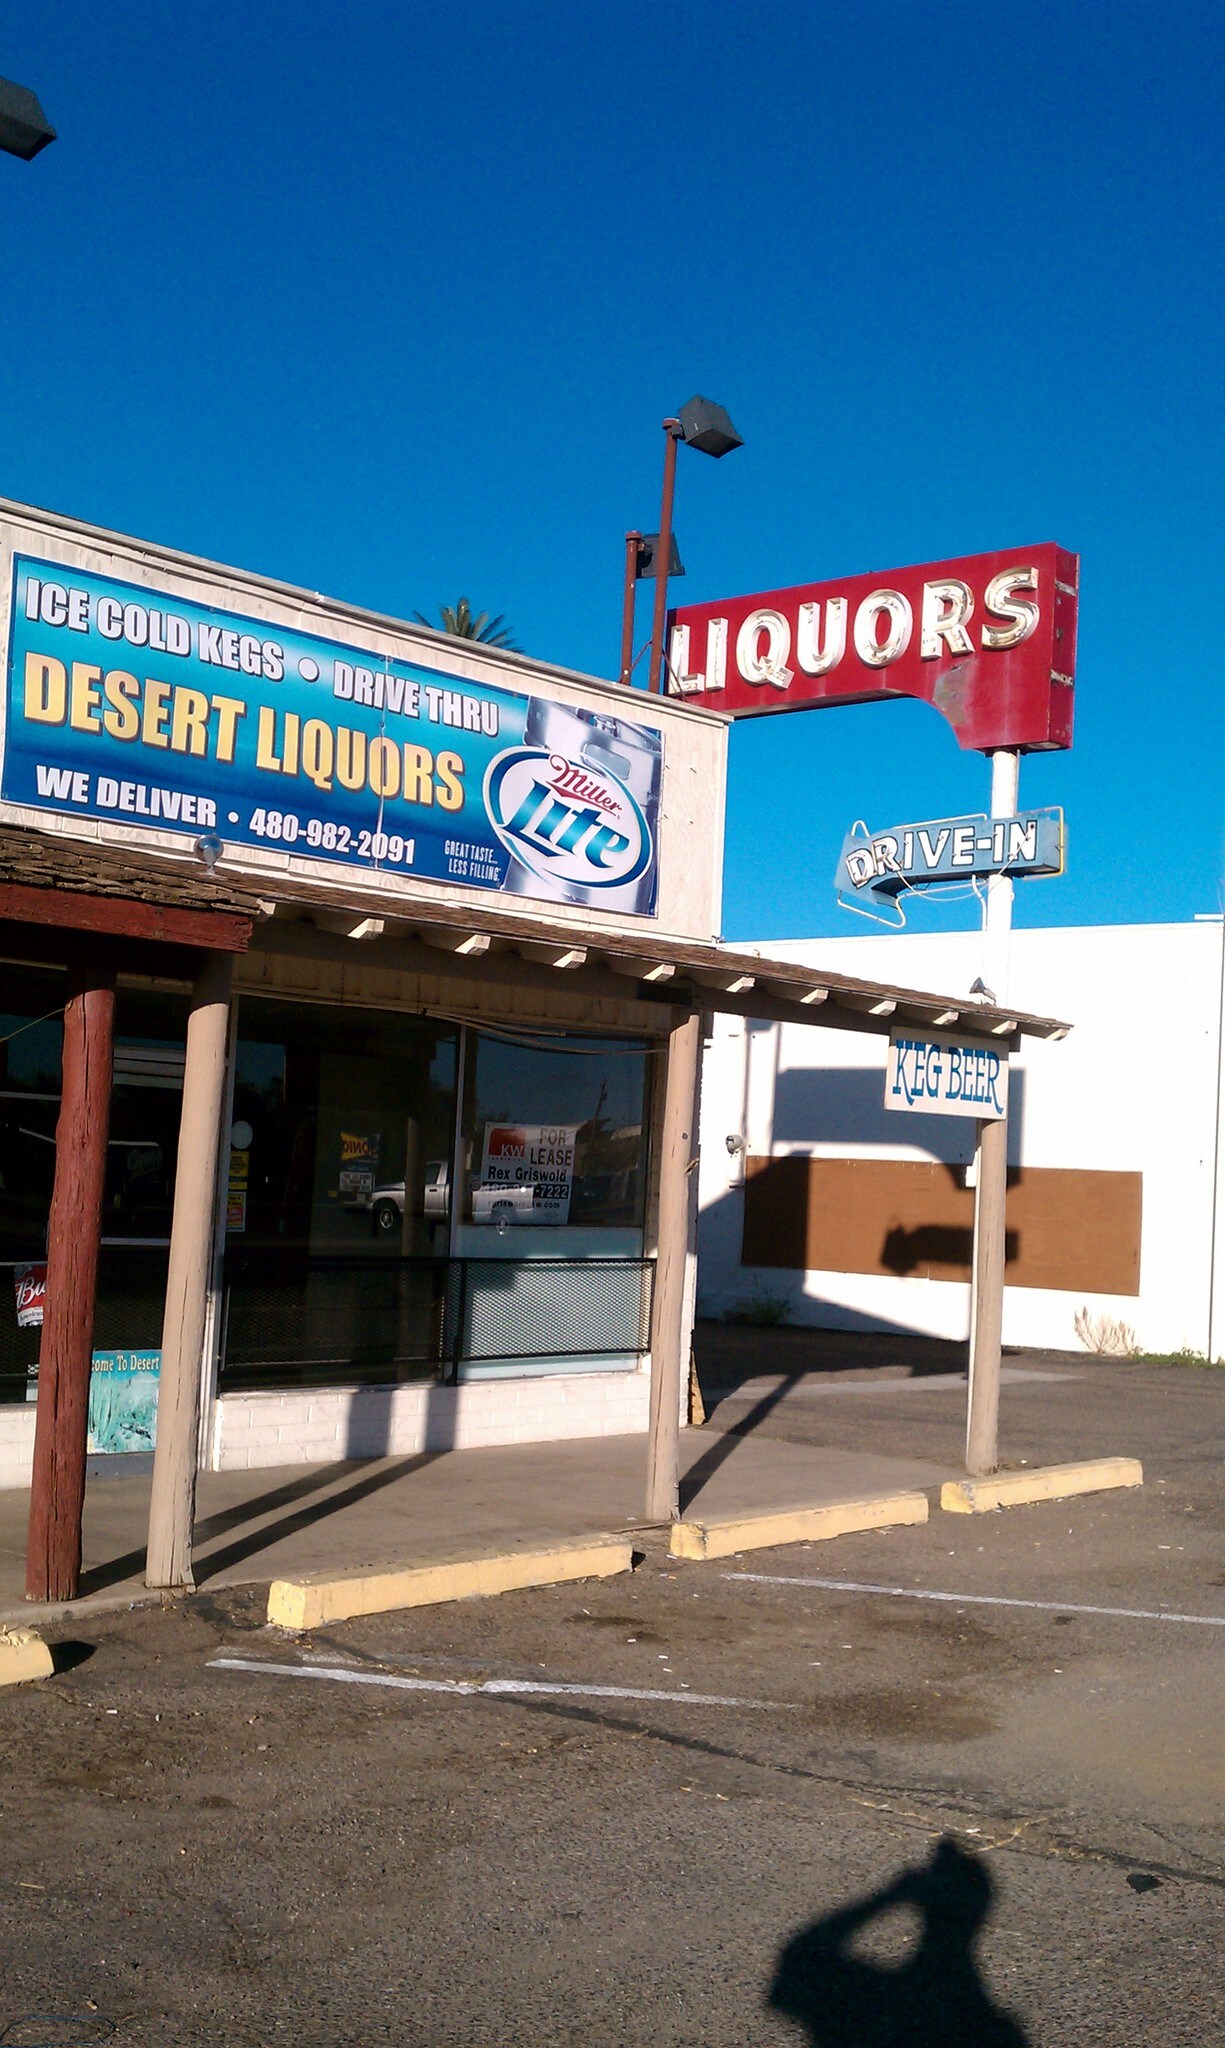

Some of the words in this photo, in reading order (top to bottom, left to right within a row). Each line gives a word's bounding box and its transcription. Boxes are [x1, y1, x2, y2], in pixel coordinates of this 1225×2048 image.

[25, 576, 90, 634] ICE
[97, 596, 191, 657] COLD
[198, 621, 285, 683] KEGS
[333, 659, 421, 720] DRIVE
[424, 685, 499, 738] THRU
[667, 566, 1041, 695] LIQUORS
[24, 650, 248, 763] DESERT
[255, 704, 466, 814] LIQUORS
[549, 754, 622, 812] Miller
[35, 764, 90, 804] WE
[95, 776, 218, 828] DELIVER
[248, 807, 416, 866] 480-982-2091
[501, 777, 631, 869] Lite
[444, 840, 471, 859] GREAT
[448, 857, 468, 876] LESS
[845, 819, 1038, 890] DRIVE-IN
[892, 1039, 943, 1106] KEG
[945, 1046, 1005, 1115] BEER
[501, 1144, 525, 1157] KW
[529, 1147, 573, 1167] LEASE
[540, 1127, 567, 1146] FOR
[487, 1165, 511, 1181] Rex
[515, 1167, 567, 1183] Griswold
[116, 1354, 128, 1371] To
[130, 1354, 160, 1371] Desert
